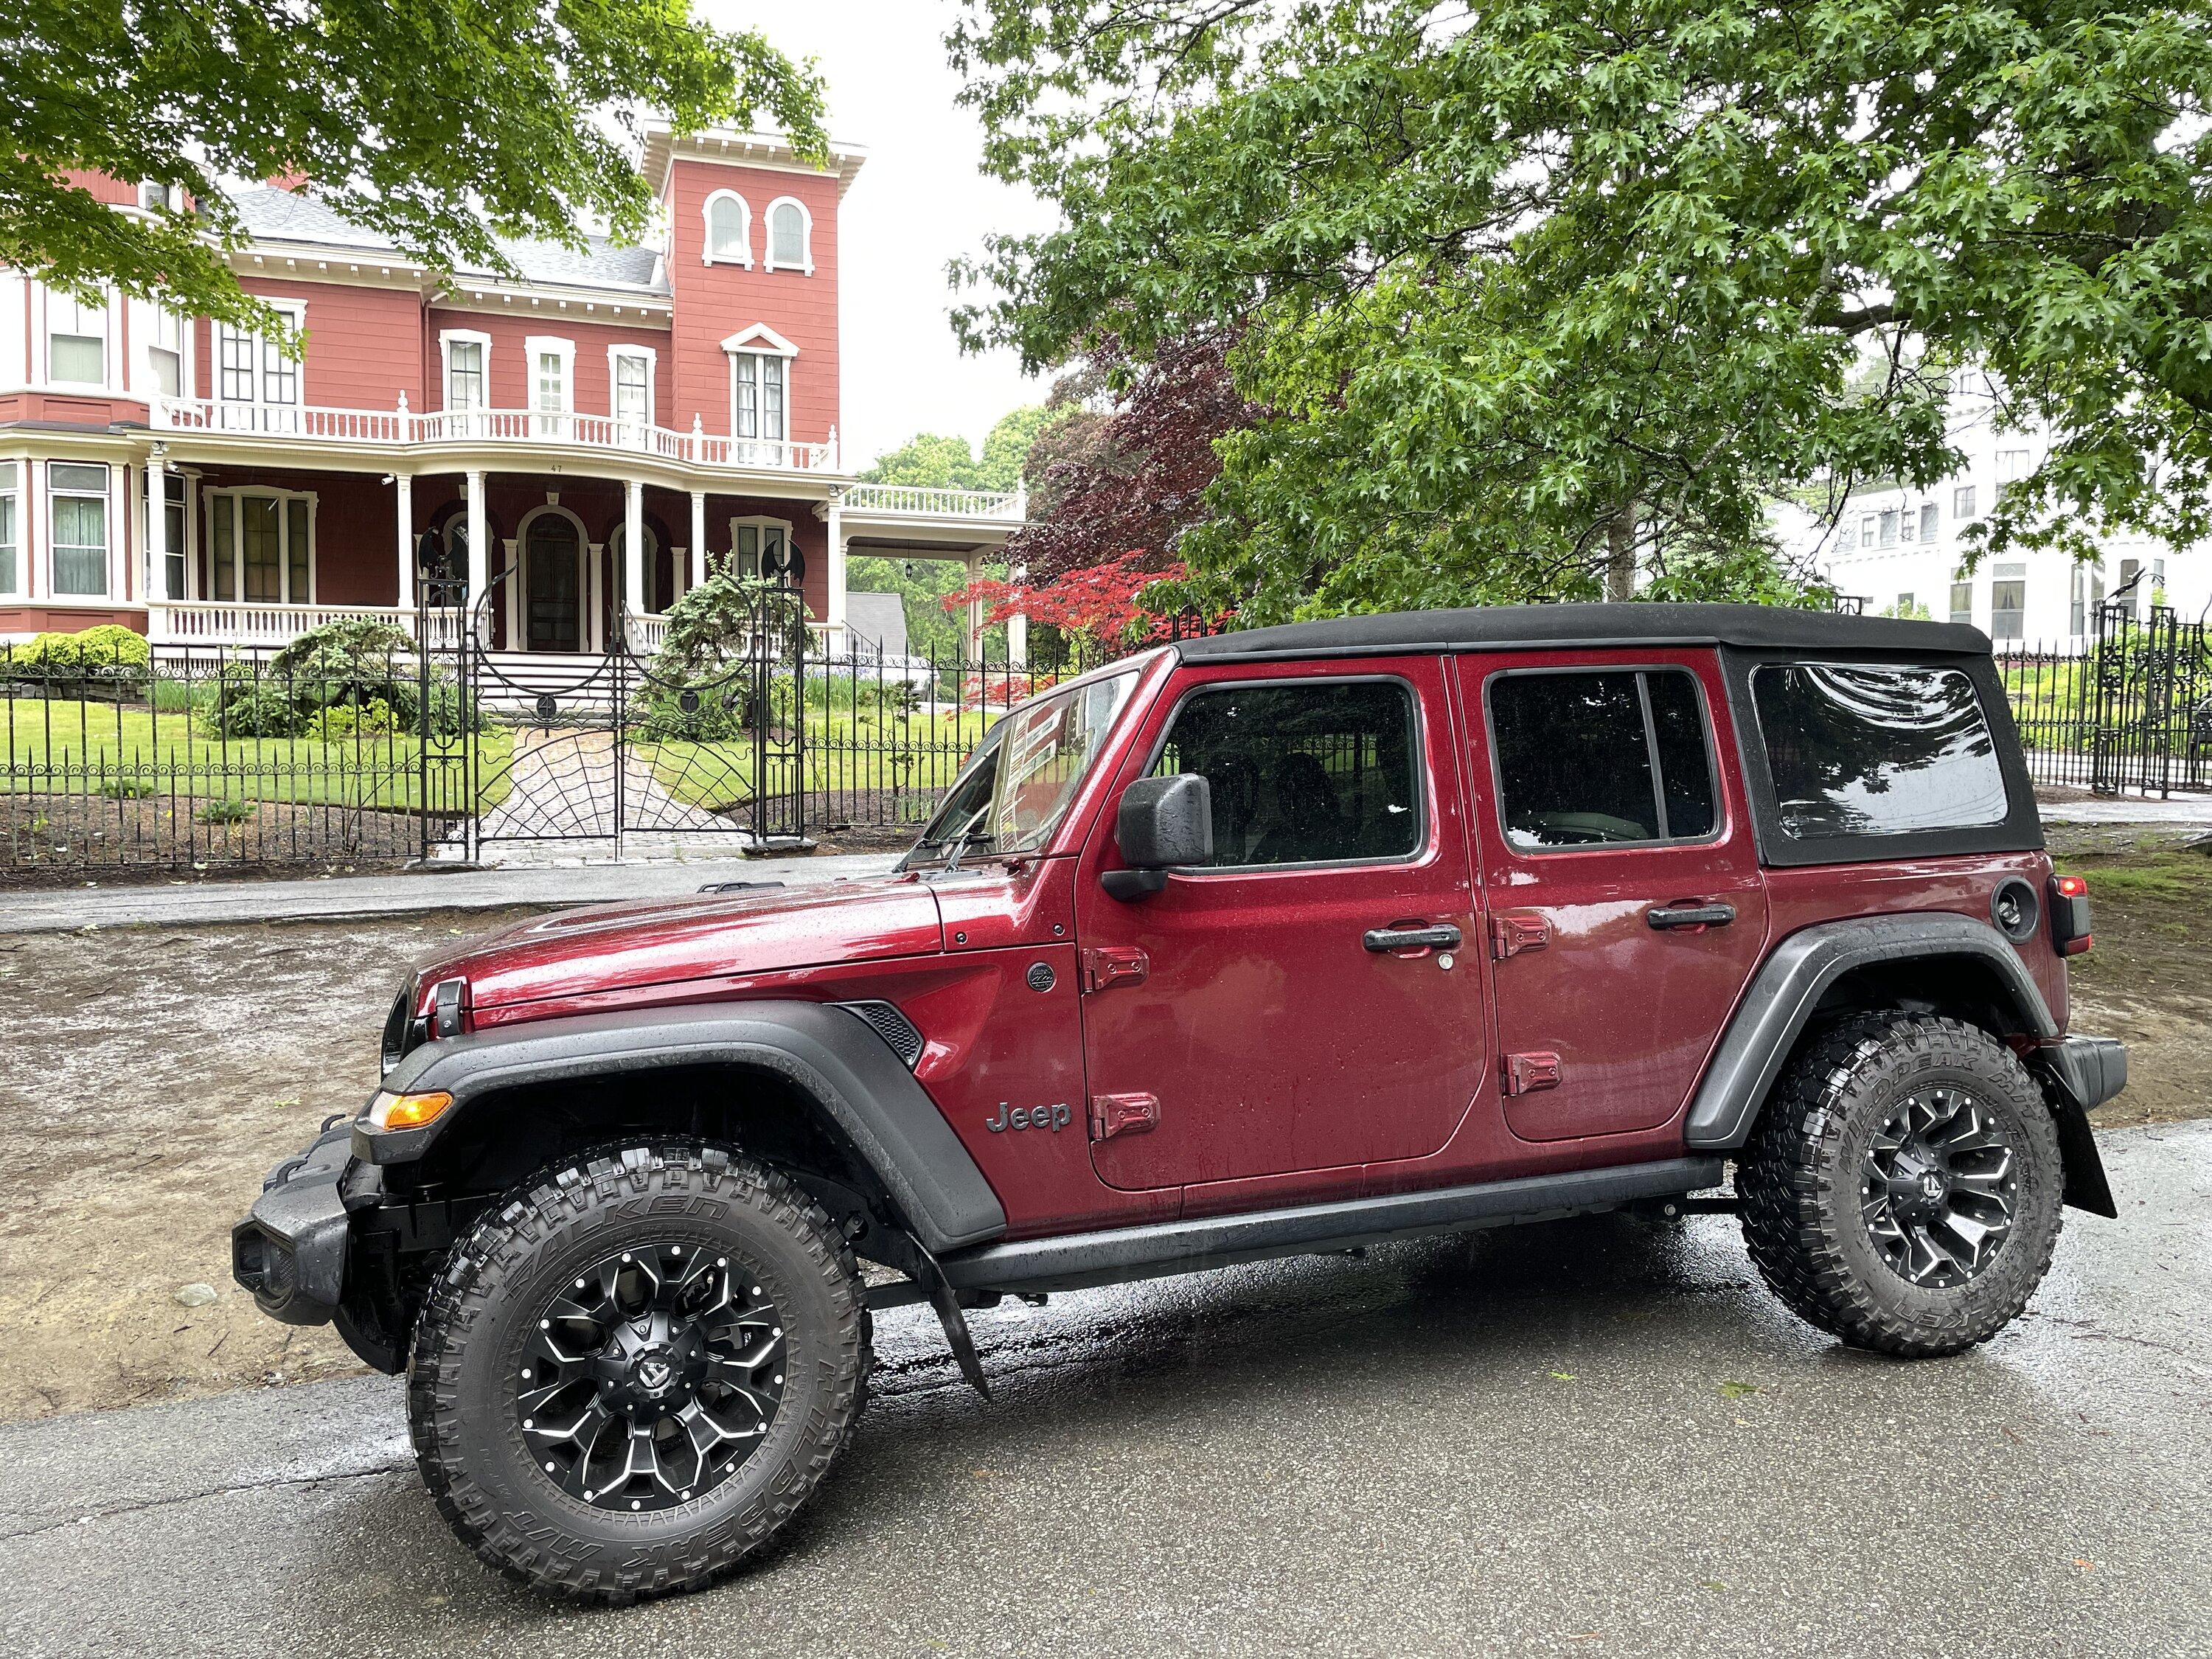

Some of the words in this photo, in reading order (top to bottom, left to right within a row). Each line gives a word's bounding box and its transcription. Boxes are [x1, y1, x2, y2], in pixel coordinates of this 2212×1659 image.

[538, 696, 552, 714] 4
[685, 692, 695, 712] 7
[986, 1102, 1072, 1133] Jeep
[1839, 1052, 1978, 1174] WILDPEAK
[501, 1194, 729, 1302] FALKEN
[622, 1358, 838, 1568] WILDPEAK
[502, 1512, 605, 1562] M/T
